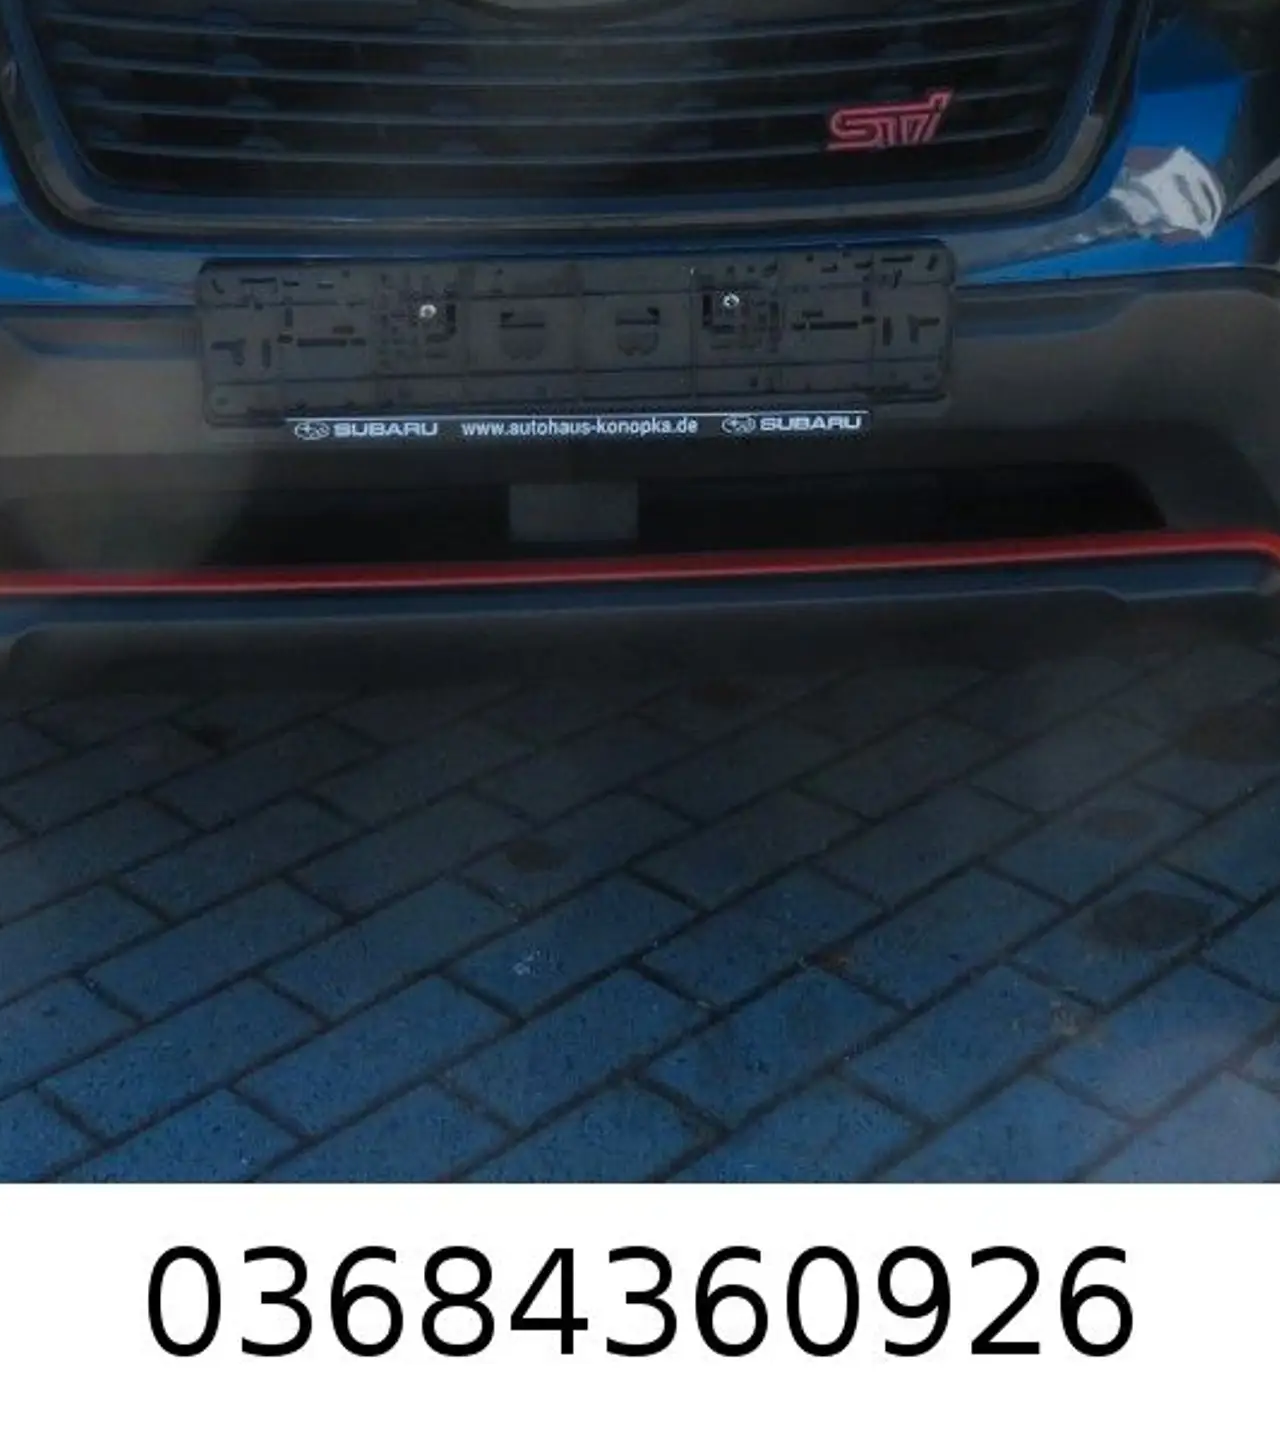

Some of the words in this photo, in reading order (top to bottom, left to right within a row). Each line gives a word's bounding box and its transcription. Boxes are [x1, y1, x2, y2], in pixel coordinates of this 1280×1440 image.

[333, 421, 438, 436] SUBARU
[461, 417, 698, 436] www.autohaus-konopka.de
[760, 415, 862, 431] SUBARU
